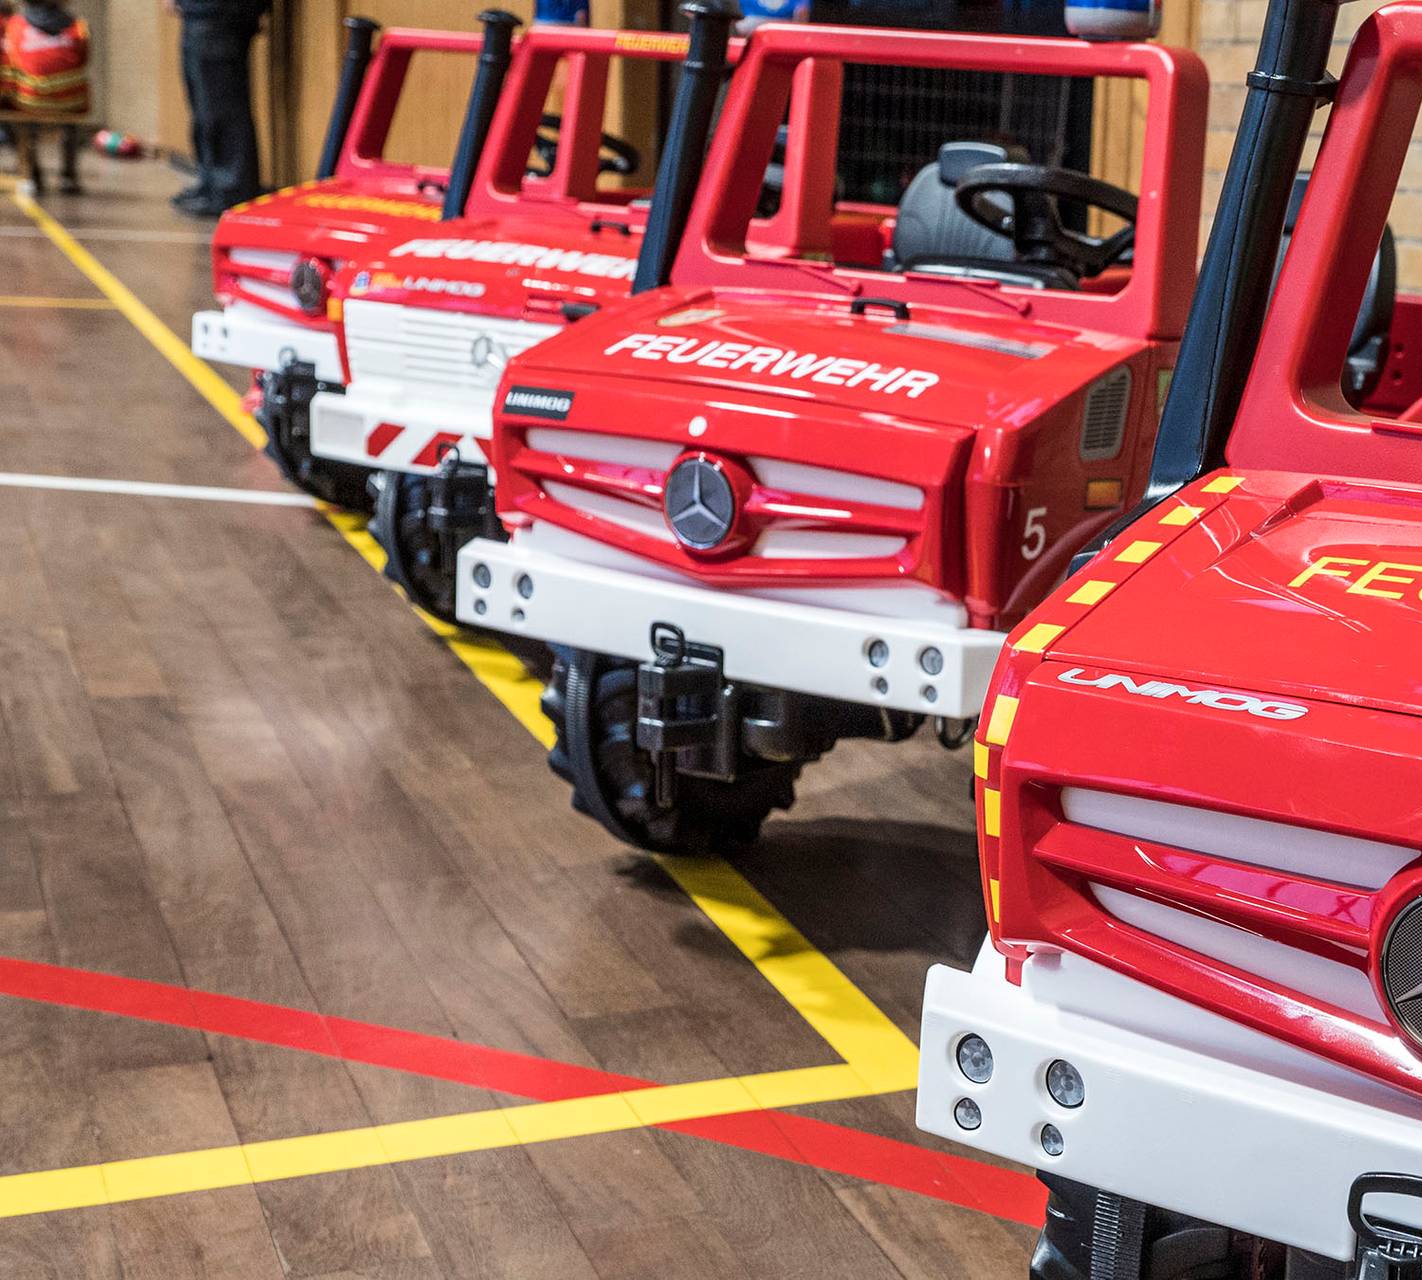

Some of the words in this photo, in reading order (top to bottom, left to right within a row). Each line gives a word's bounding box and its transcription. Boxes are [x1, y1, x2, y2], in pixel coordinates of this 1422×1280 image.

[388, 239, 639, 281] FEUERWEH
[604, 333, 939, 398] FEUERWEHR
[505, 391, 572, 412] UNIMOG
[1021, 507, 1047, 560] 5
[1057, 668, 1309, 720] UNIMOG
